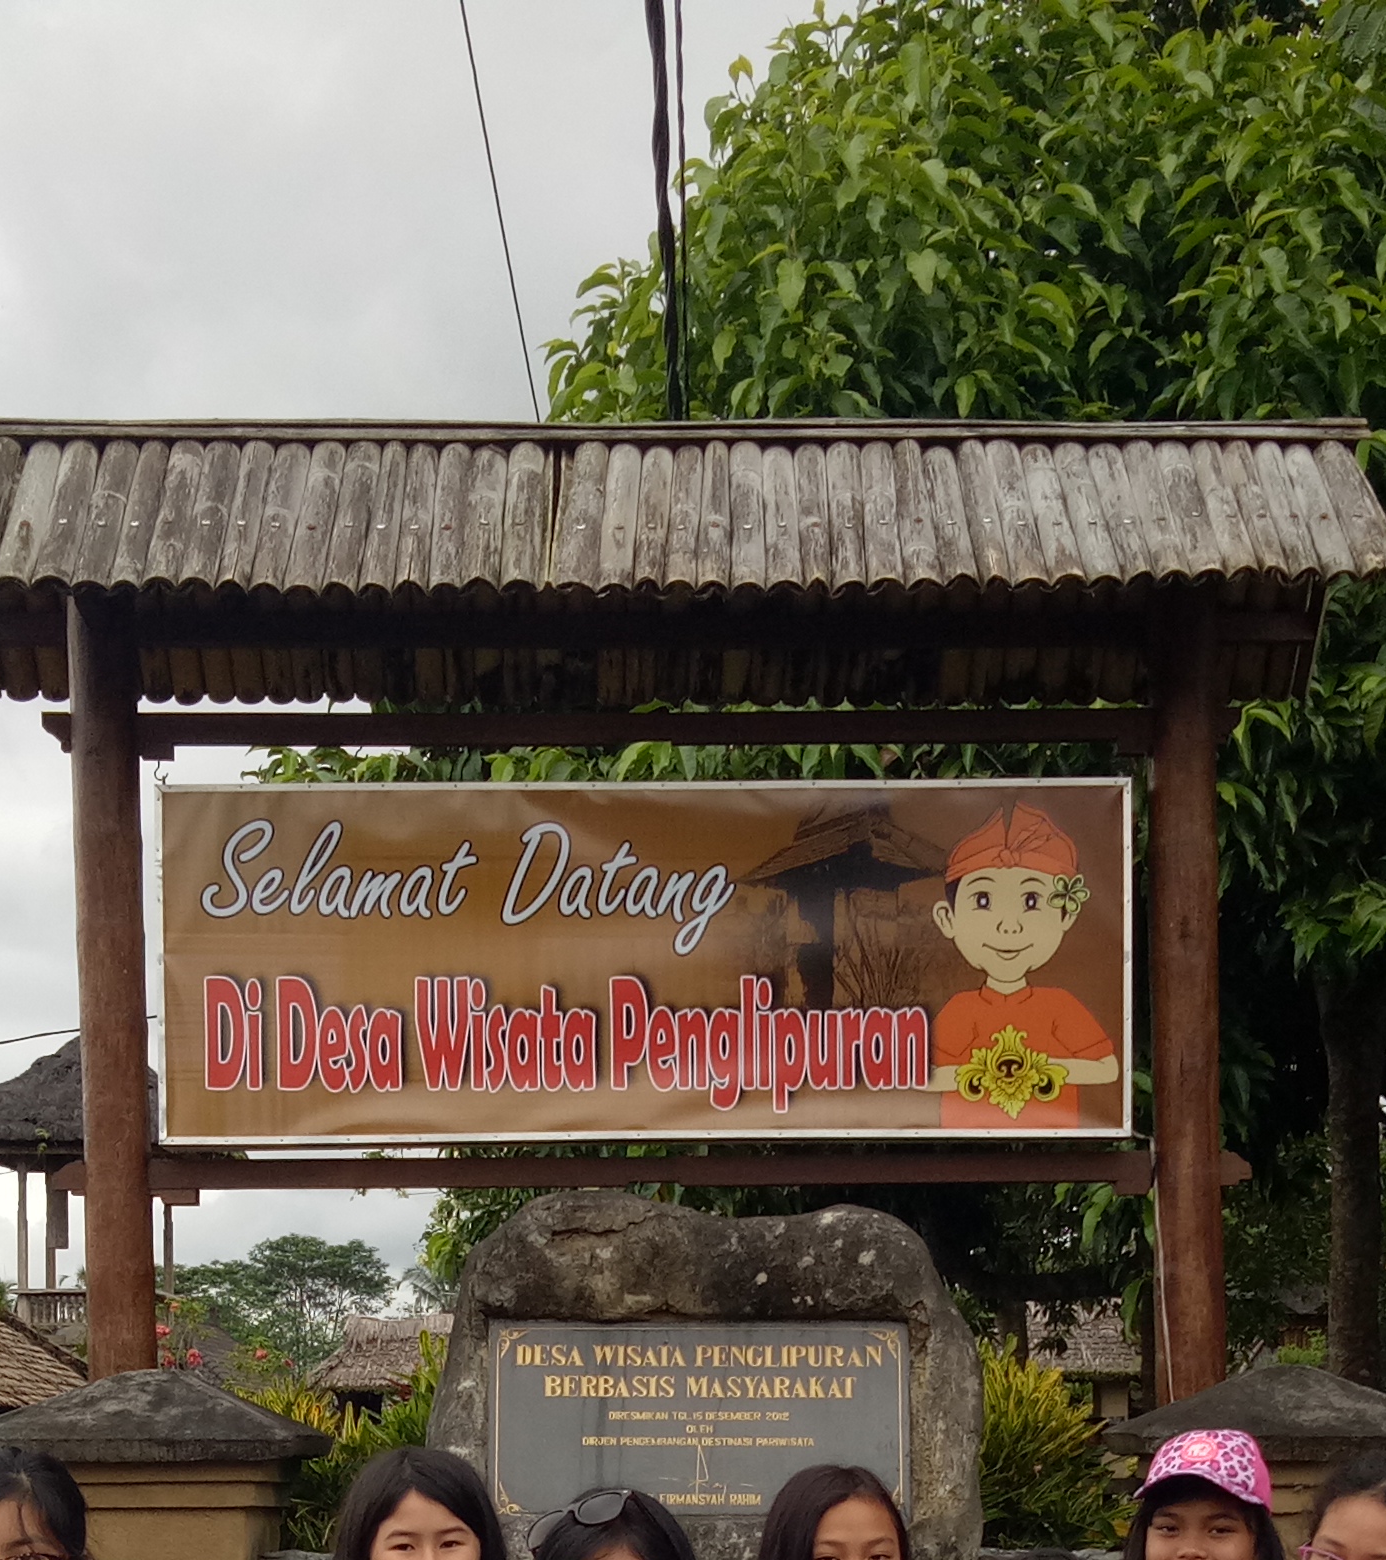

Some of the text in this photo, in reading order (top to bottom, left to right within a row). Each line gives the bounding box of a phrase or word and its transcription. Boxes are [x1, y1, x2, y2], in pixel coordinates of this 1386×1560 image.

[200, 819, 734, 955] Selamat Datang
[204, 975, 929, 1113] Di Desa Wisata Penglipuran
[515, 1344, 883, 1368] DESA WISATA PENGLIPURAN
[544, 1375, 856, 1399] BERBASIS MASYARAKAT
[608, 1411, 668, 1421] DIRESMIKAN
[705, 1411, 761, 1421] DESEMBER
[765, 1411, 790, 1421] 2012
[686, 1425, 714, 1434] OLEH
[582, 1437, 617, 1446] DIRJEN
[701, 1437, 753, 1446] DESTINASI
[756, 1437, 815, 1446] PARIWISATA
[659, 1494, 725, 1506] FIRMANSYAH
[729, 1494, 762, 1506] RAHIM
